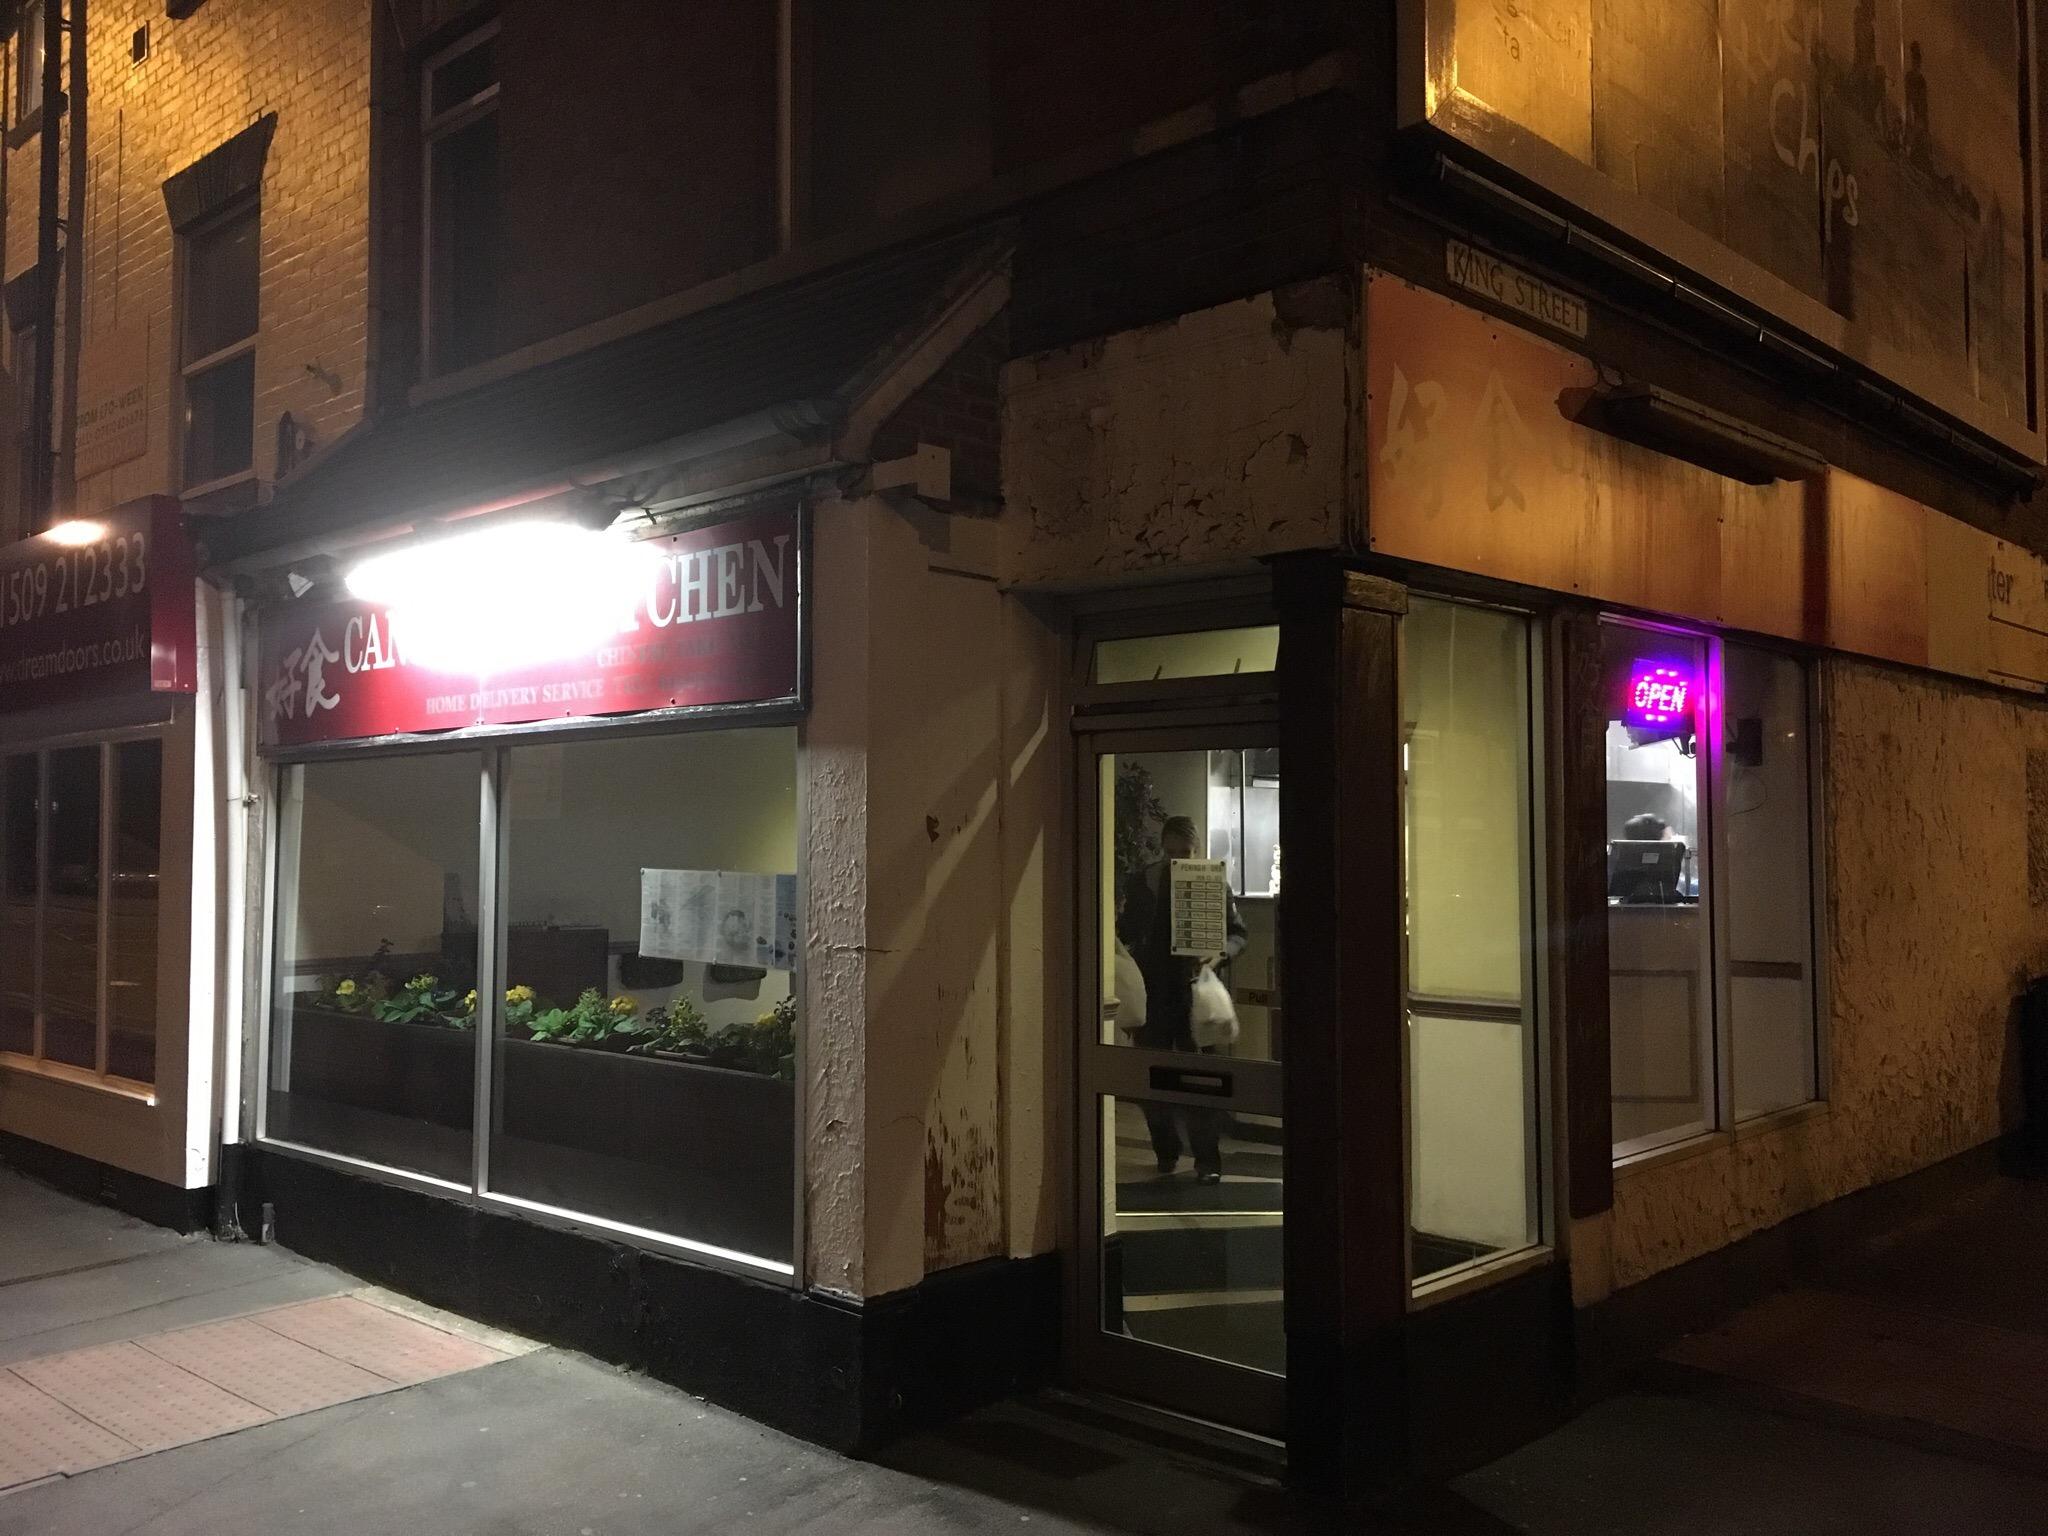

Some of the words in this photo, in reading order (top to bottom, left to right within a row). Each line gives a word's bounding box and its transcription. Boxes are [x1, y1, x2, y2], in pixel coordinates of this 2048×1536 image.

[1769, 78, 1858, 243] Chps
[1453, 246, 1503, 301] KING
[1515, 275, 1582, 331] STREET
[426, 694, 466, 715] HOME
[470, 686, 539, 710] DELIVERY
[542, 678, 605, 703] SERVICE
[1634, 681, 1687, 713] OPEN
